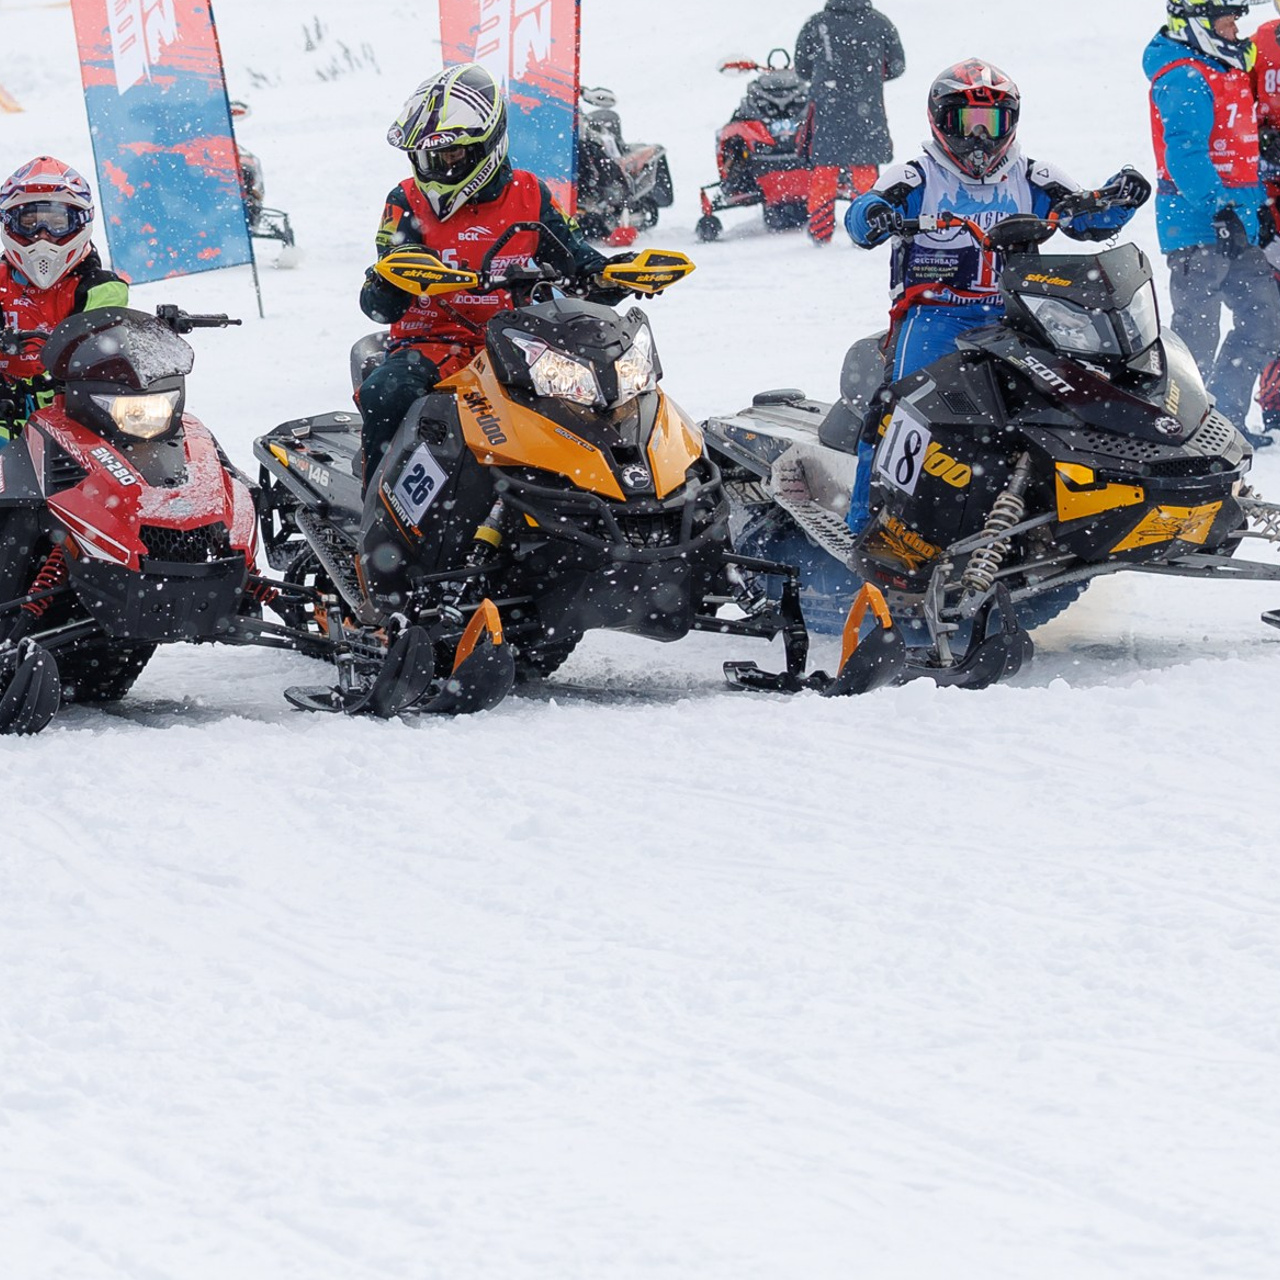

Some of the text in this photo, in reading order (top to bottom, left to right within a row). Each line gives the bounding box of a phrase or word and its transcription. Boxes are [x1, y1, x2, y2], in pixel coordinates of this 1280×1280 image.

[420, 133, 455, 150] Airoh
[402, 269, 443, 281] ski-doo
[635, 274, 674, 282] ski-doo
[1024, 273, 1072, 287] ski-doo
[1024, 356, 1076, 393] SCOTT
[463, 391, 507, 446] ski-doo
[880, 419, 922, 485] 18
[308, 464, 330, 487] 146
[402, 463, 434, 506] 26
[382, 481, 414, 528] SUMMIT
